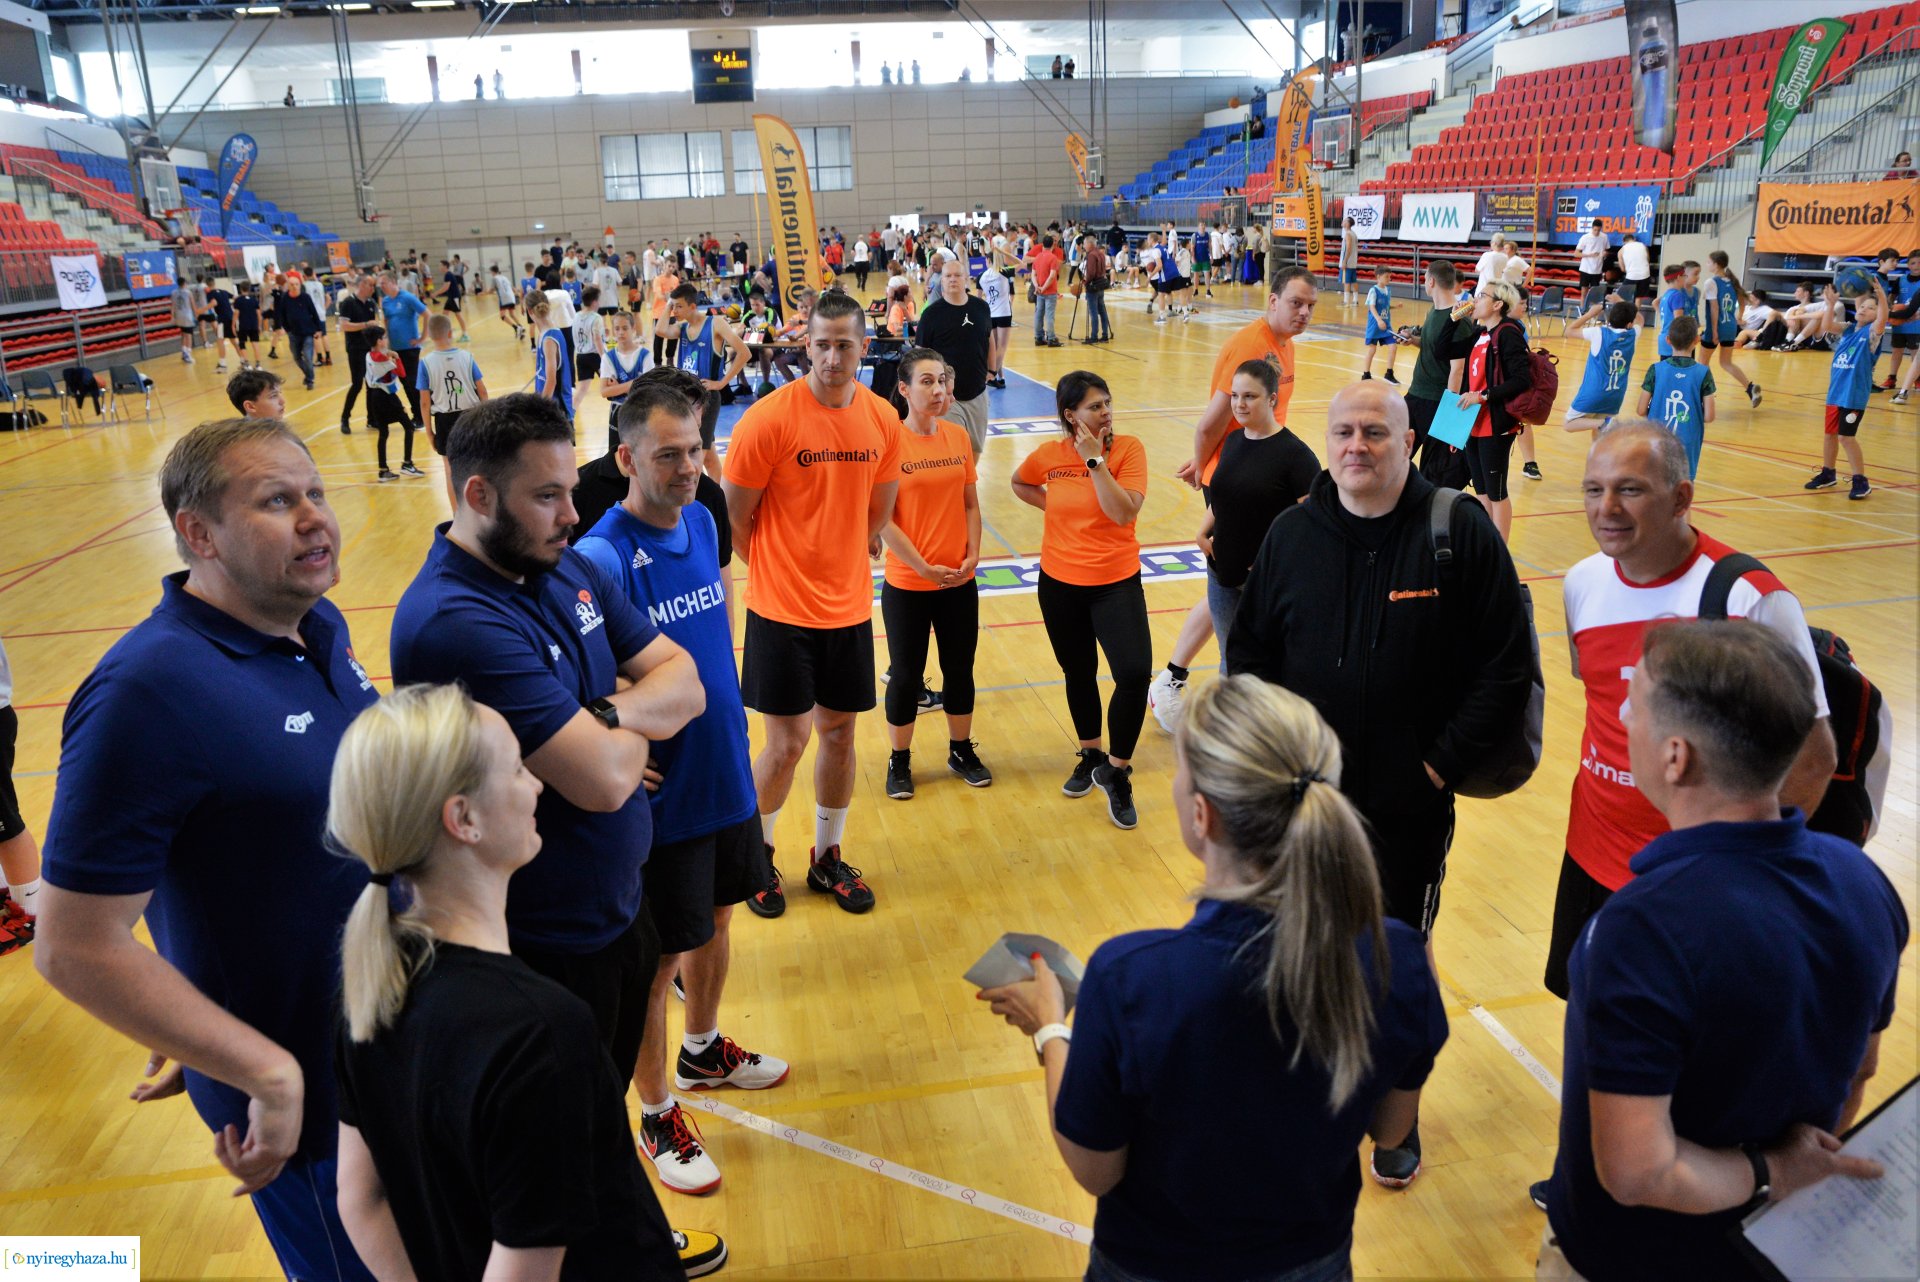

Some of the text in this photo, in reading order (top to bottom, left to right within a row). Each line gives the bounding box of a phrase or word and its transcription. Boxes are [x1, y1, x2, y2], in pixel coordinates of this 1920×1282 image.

[1776, 45, 1817, 110] Soproni
[1347, 208, 1373, 218] POWER
[1413, 206, 1459, 229] MVM
[1767, 199, 1894, 231] Continental
[797, 448, 870, 467] Continental
[901, 455, 963, 475] Continental
[647, 580, 725, 628] MICHELIN
[1388, 588, 1433, 602] Continental
[907, 1171, 952, 1191] TEQVOLY
[1001, 1202, 1049, 1225] TEQVOLY
